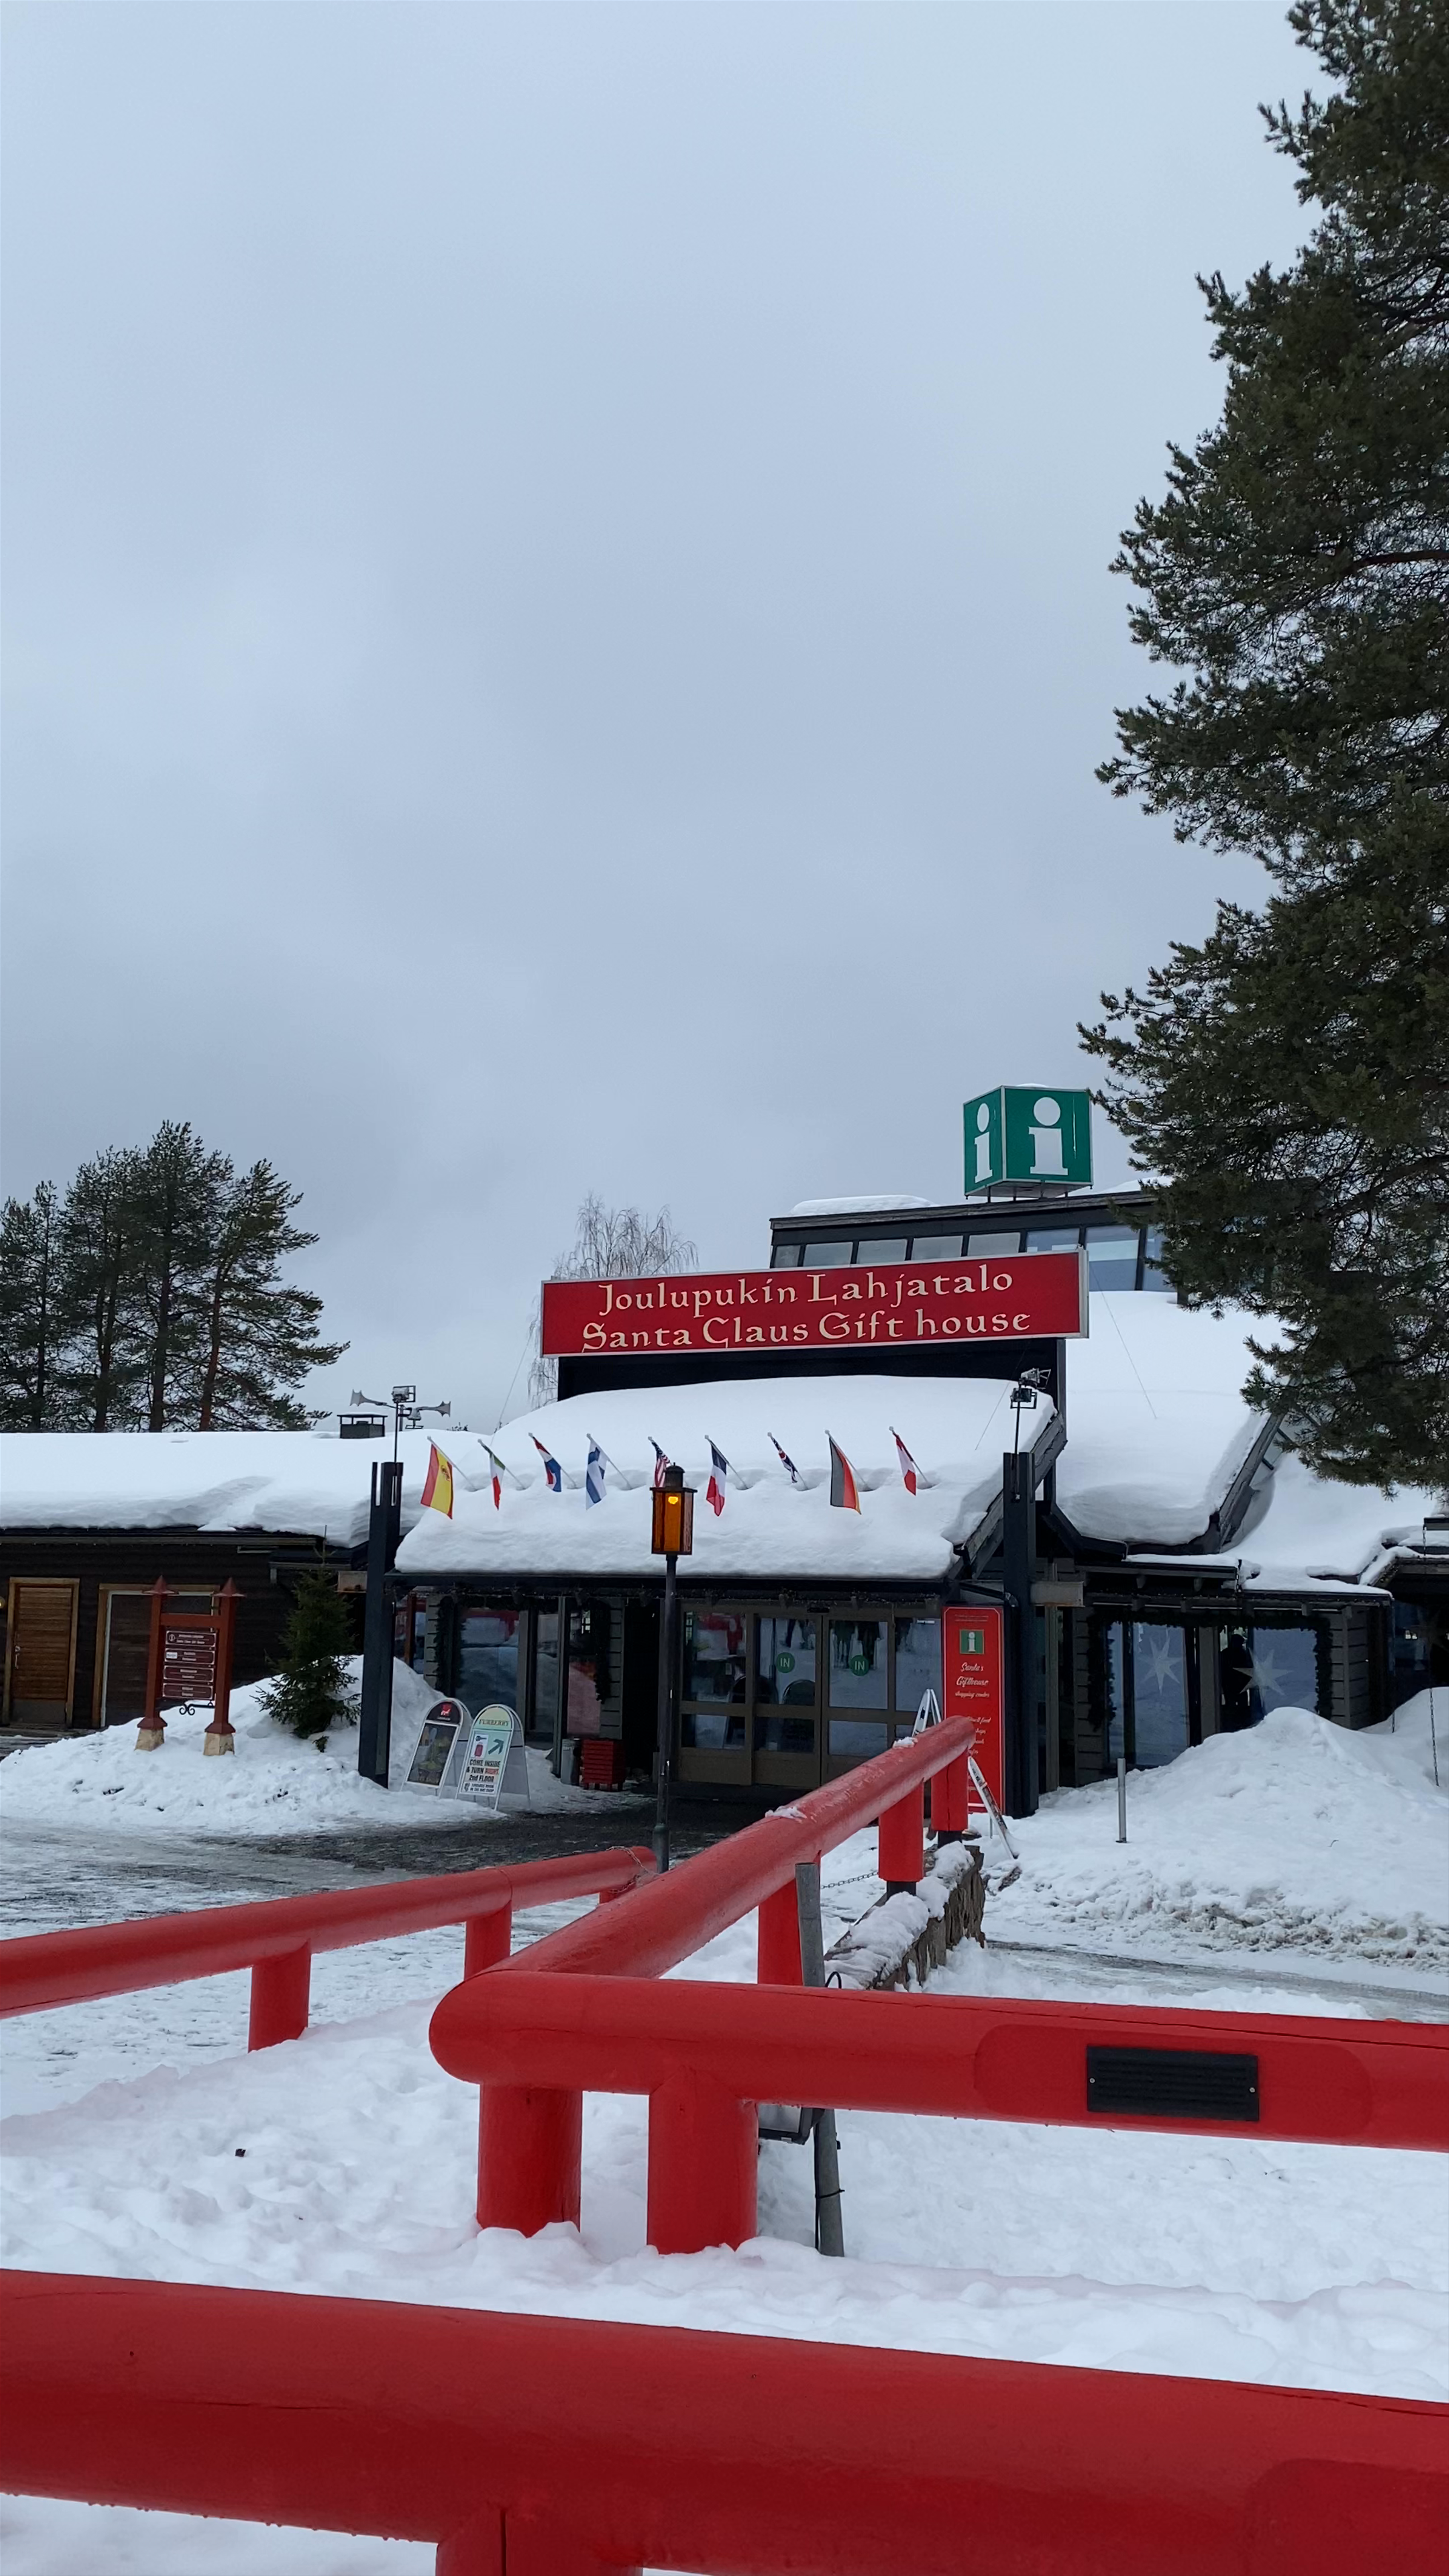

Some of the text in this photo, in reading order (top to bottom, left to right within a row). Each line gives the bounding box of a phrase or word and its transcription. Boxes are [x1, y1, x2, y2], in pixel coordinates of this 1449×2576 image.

[598, 1264, 1013, 1318] Joulupukin Lahjatalo
[581, 1309, 1031, 1353] Santa Claus Gift house
[780, 1658, 790, 1668] IN
[855, 1661, 865, 1670] IN
